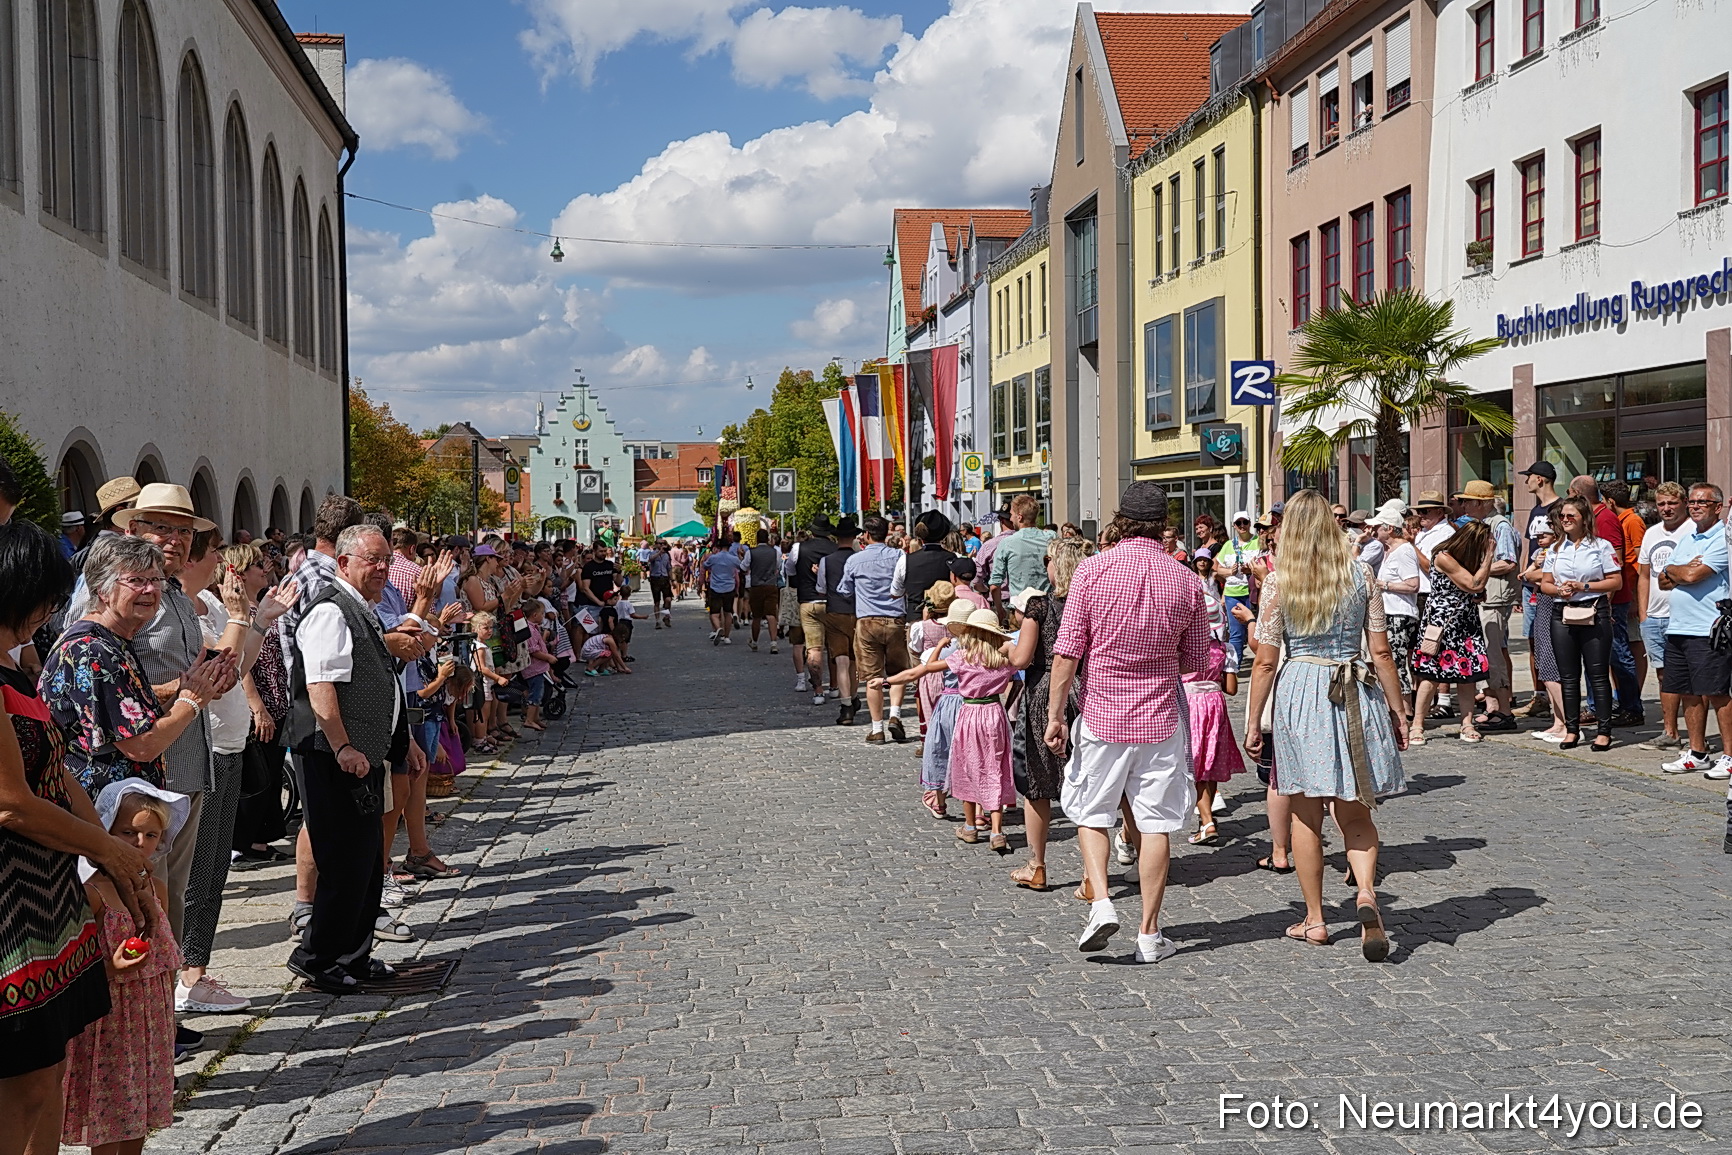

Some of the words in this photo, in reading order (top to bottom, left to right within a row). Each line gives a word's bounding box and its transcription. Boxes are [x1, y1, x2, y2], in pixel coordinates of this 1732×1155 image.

[1497, 292, 1625, 338] Buchhandlung
[1216, 435, 1231, 453] G2
[969, 458, 977, 468] H
